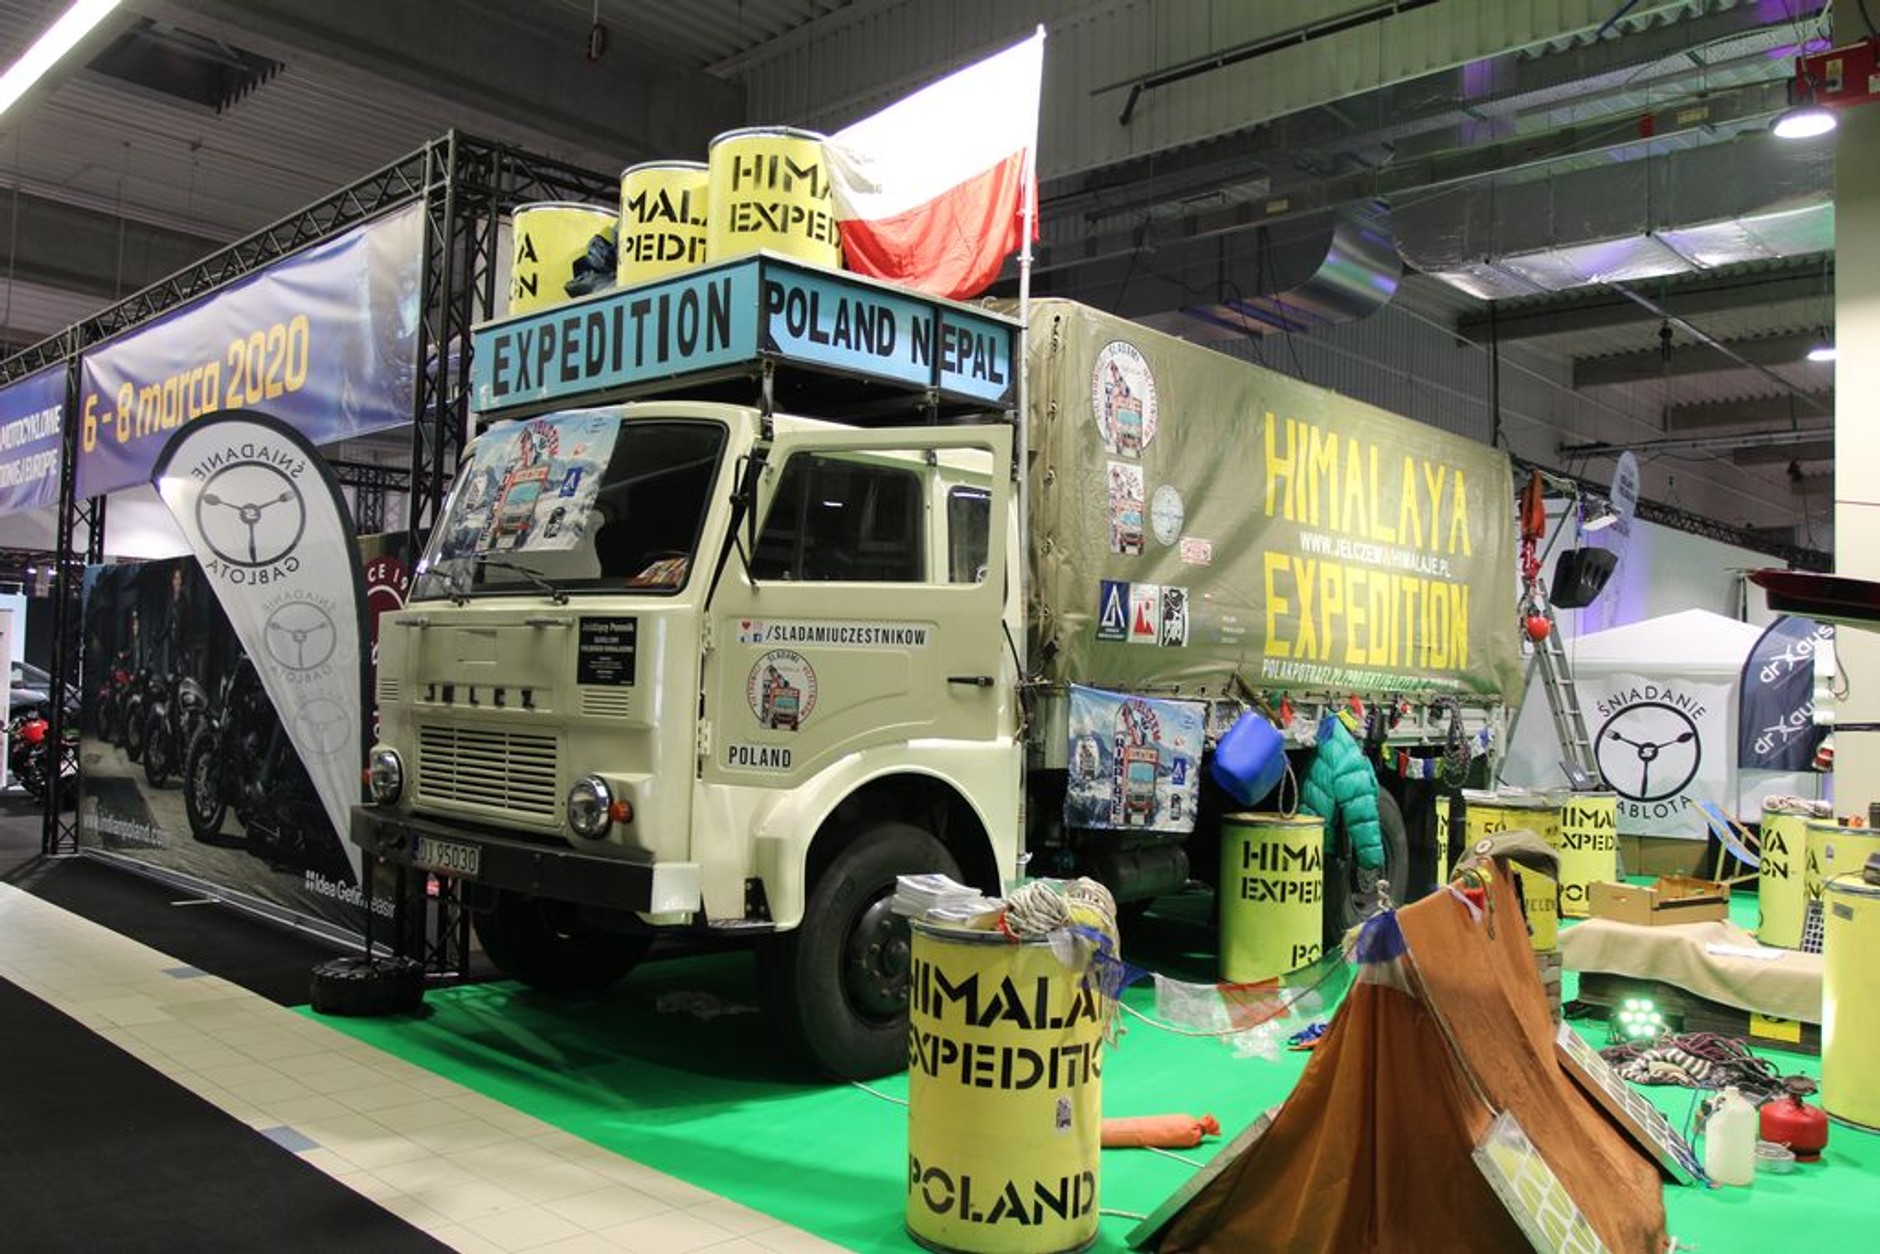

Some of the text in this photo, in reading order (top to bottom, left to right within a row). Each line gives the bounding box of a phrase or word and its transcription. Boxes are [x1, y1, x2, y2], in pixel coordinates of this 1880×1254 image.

[493, 277, 732, 398] EXPEDITION
[766, 280, 896, 357] POLAND
[83, 393, 98, 453] 6
[116, 382, 134, 443] 8
[136, 360, 221, 438] marca
[226, 314, 309, 409] 2020
[1264, 411, 1472, 558] HIMALAYA
[1263, 551, 1470, 671] EXPEDITION
[424, 682, 537, 710] JELCZ
[729, 746, 792, 769] POLAND
[1616, 794, 1692, 820] ABLOTA
[909, 1151, 1096, 1226] POLAND
